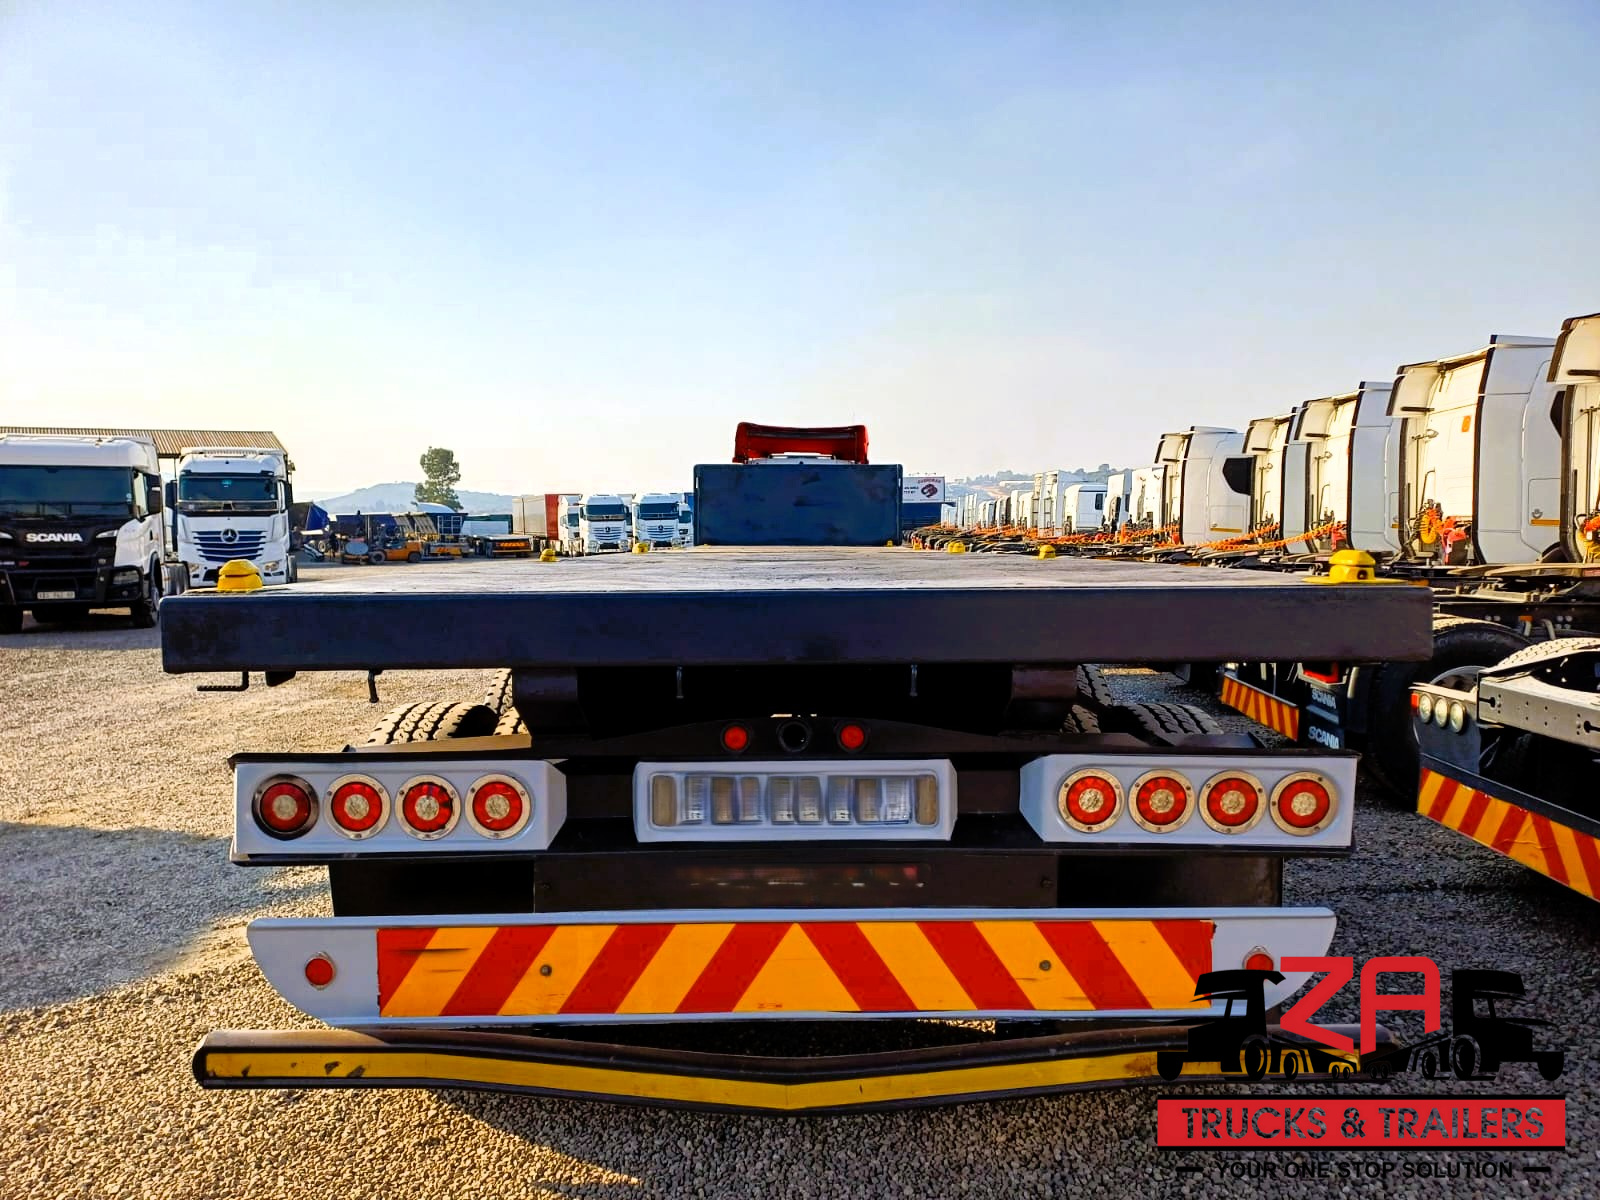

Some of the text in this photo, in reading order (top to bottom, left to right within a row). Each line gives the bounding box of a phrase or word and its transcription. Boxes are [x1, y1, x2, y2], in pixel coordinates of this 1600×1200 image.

[26, 533, 83, 543] SCANIA
[1311, 688, 1337, 709] SCANIA
[1308, 726, 1339, 749] SCANIA
